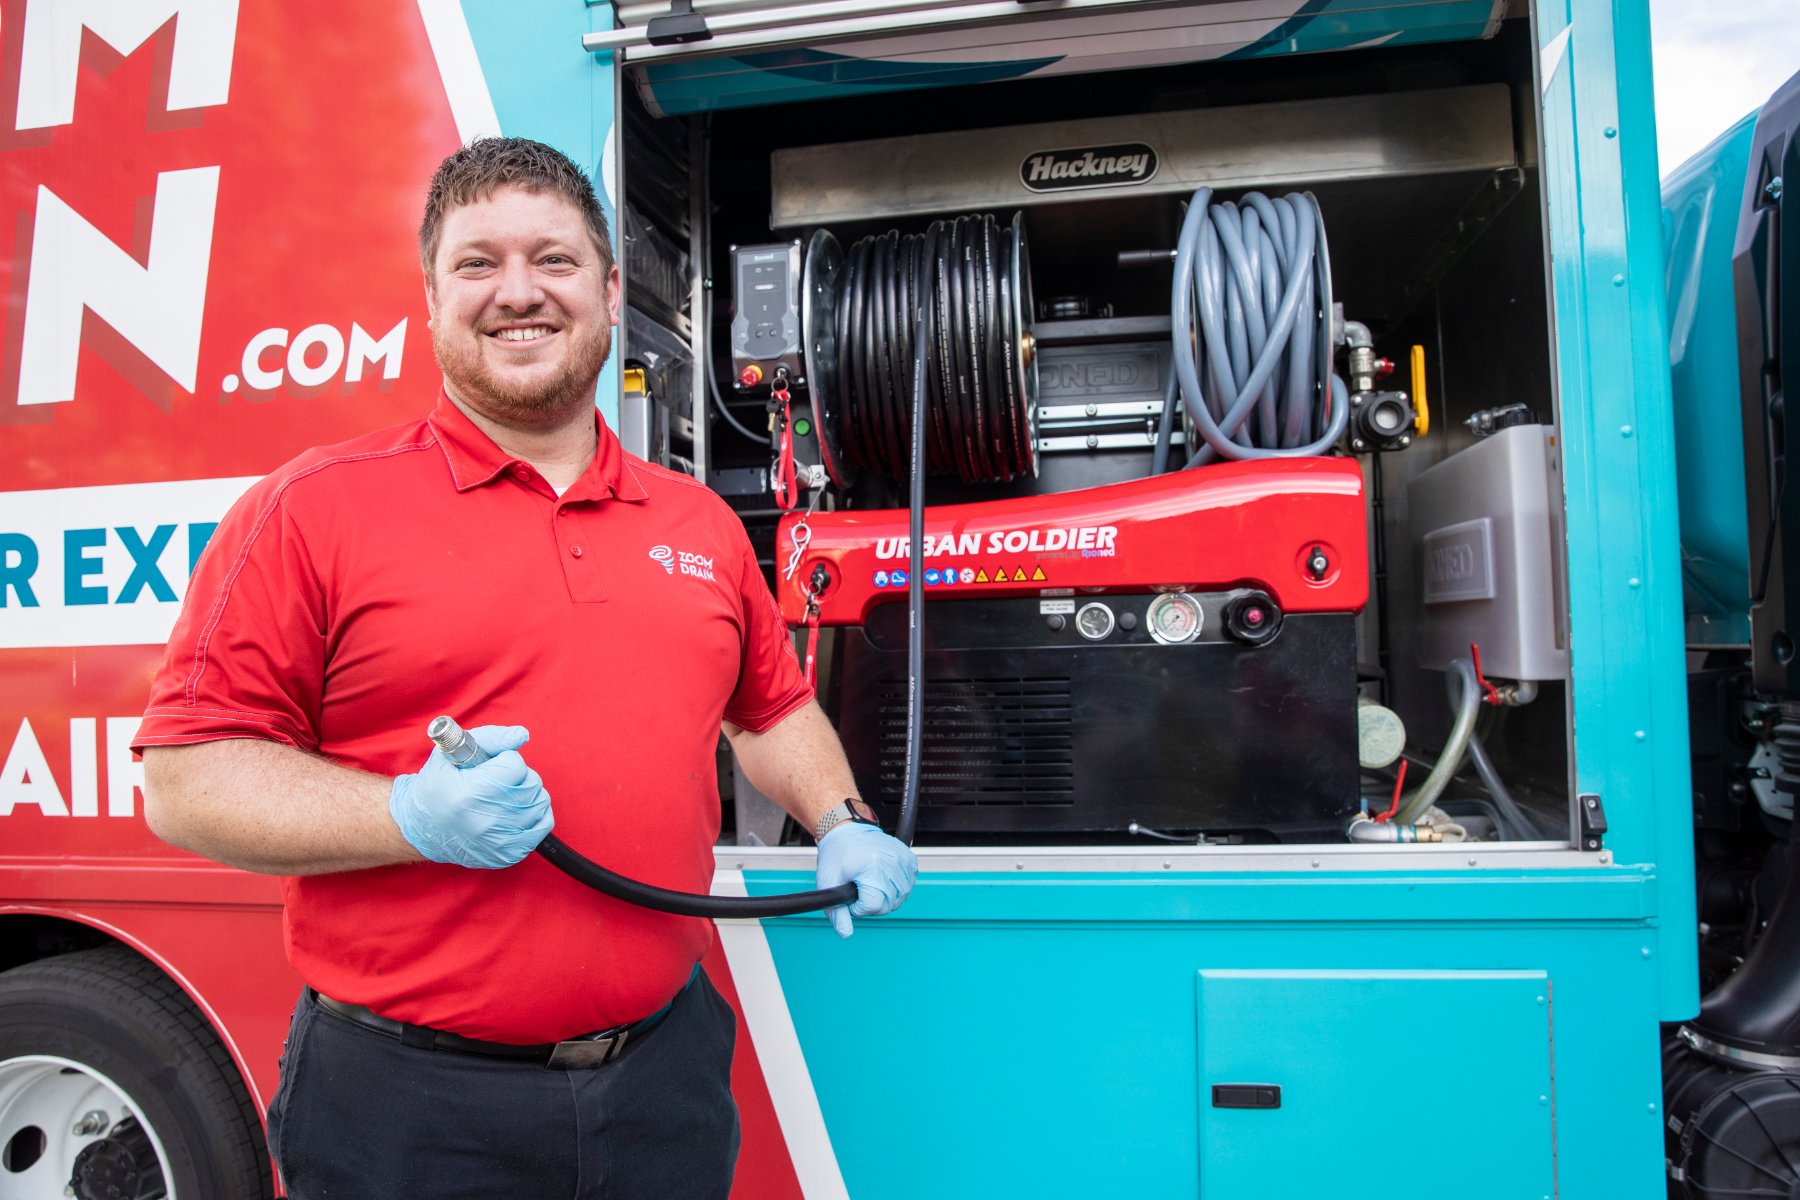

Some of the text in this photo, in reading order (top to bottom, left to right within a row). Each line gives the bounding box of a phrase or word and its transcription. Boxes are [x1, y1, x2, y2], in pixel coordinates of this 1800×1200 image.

[1028, 152, 1149, 181] Hackney
[876, 527, 1118, 559] URBAN SOLDIER
[678, 551, 713, 569] ZOOM
[680, 563, 716, 581] DRAIN
